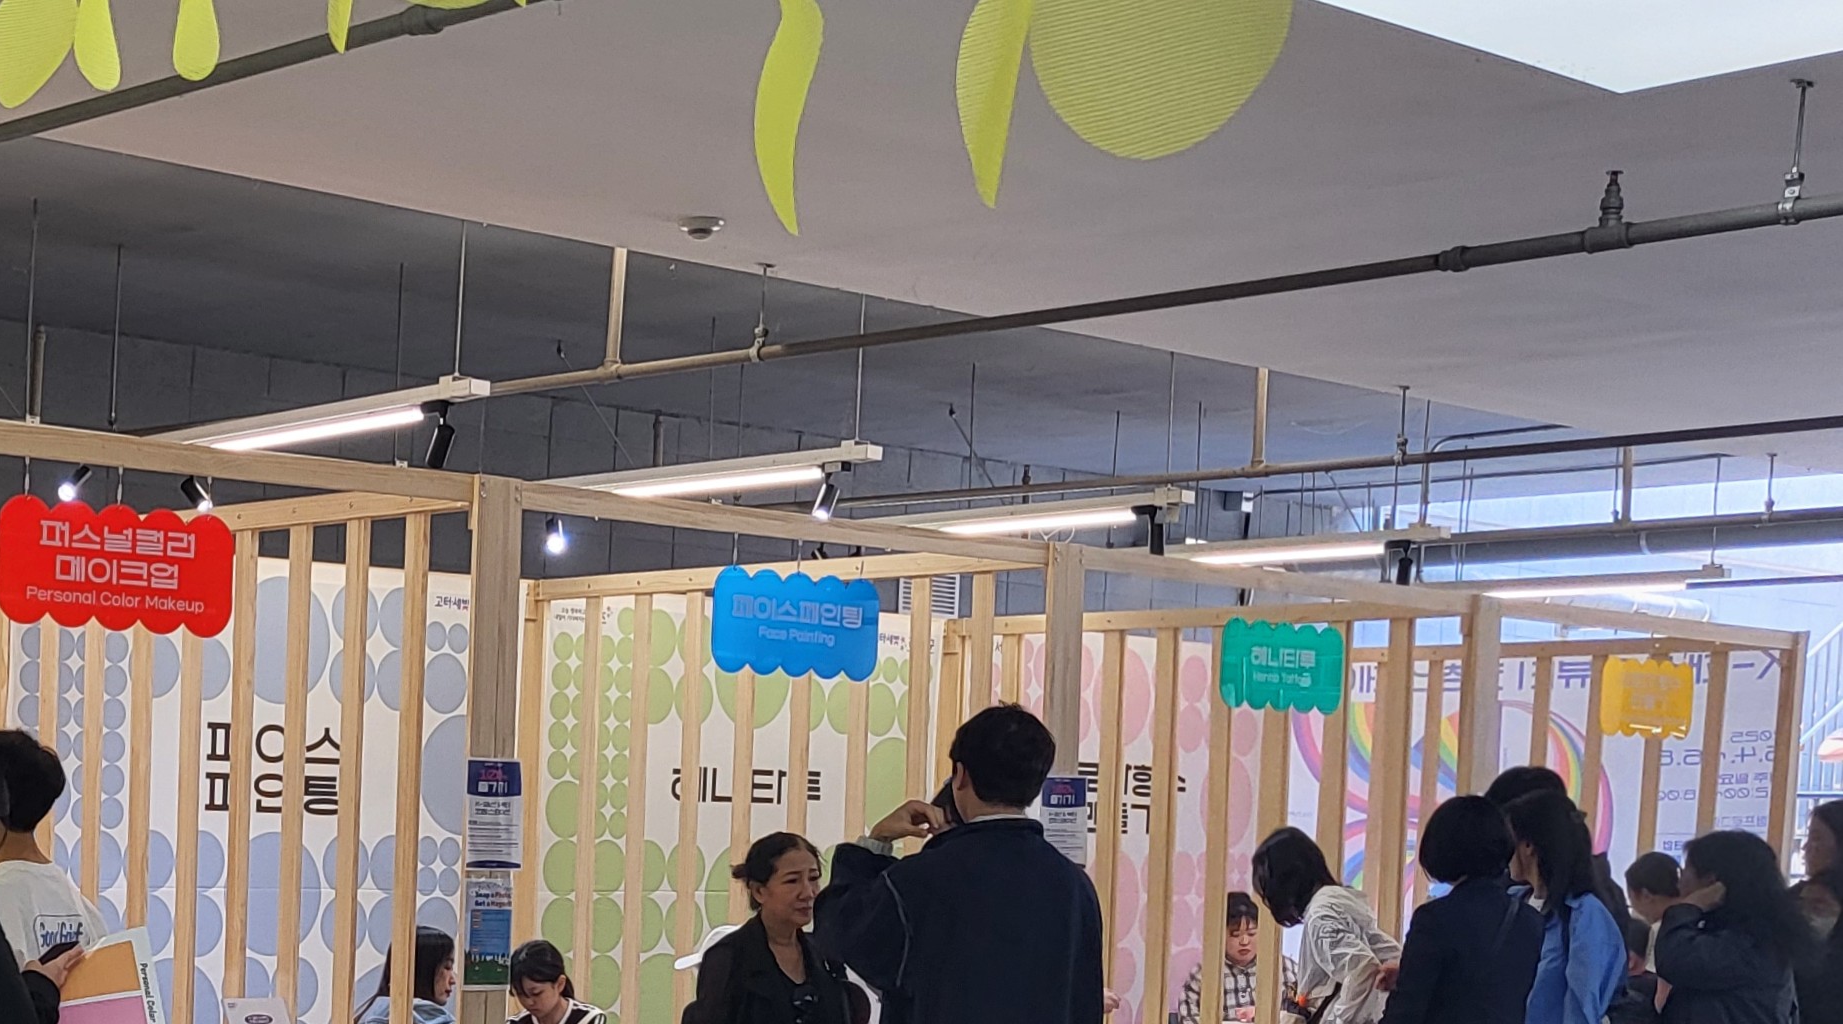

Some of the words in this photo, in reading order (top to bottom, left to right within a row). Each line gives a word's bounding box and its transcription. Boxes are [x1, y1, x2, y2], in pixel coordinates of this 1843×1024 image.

[39, 520, 196, 560] 퍼스널컬러
[55, 554, 179, 590] 메이크업
[26, 585, 96, 605] Personal
[100, 592, 141, 609] Color
[145, 595, 205, 615] Makeup
[732, 594, 863, 630] 페이스페인팅
[758, 625, 788, 641] Face
[789, 629, 836, 648] Painting
[139, 962, 154, 999] Personal
[146, 1000, 157, 1023] Color
